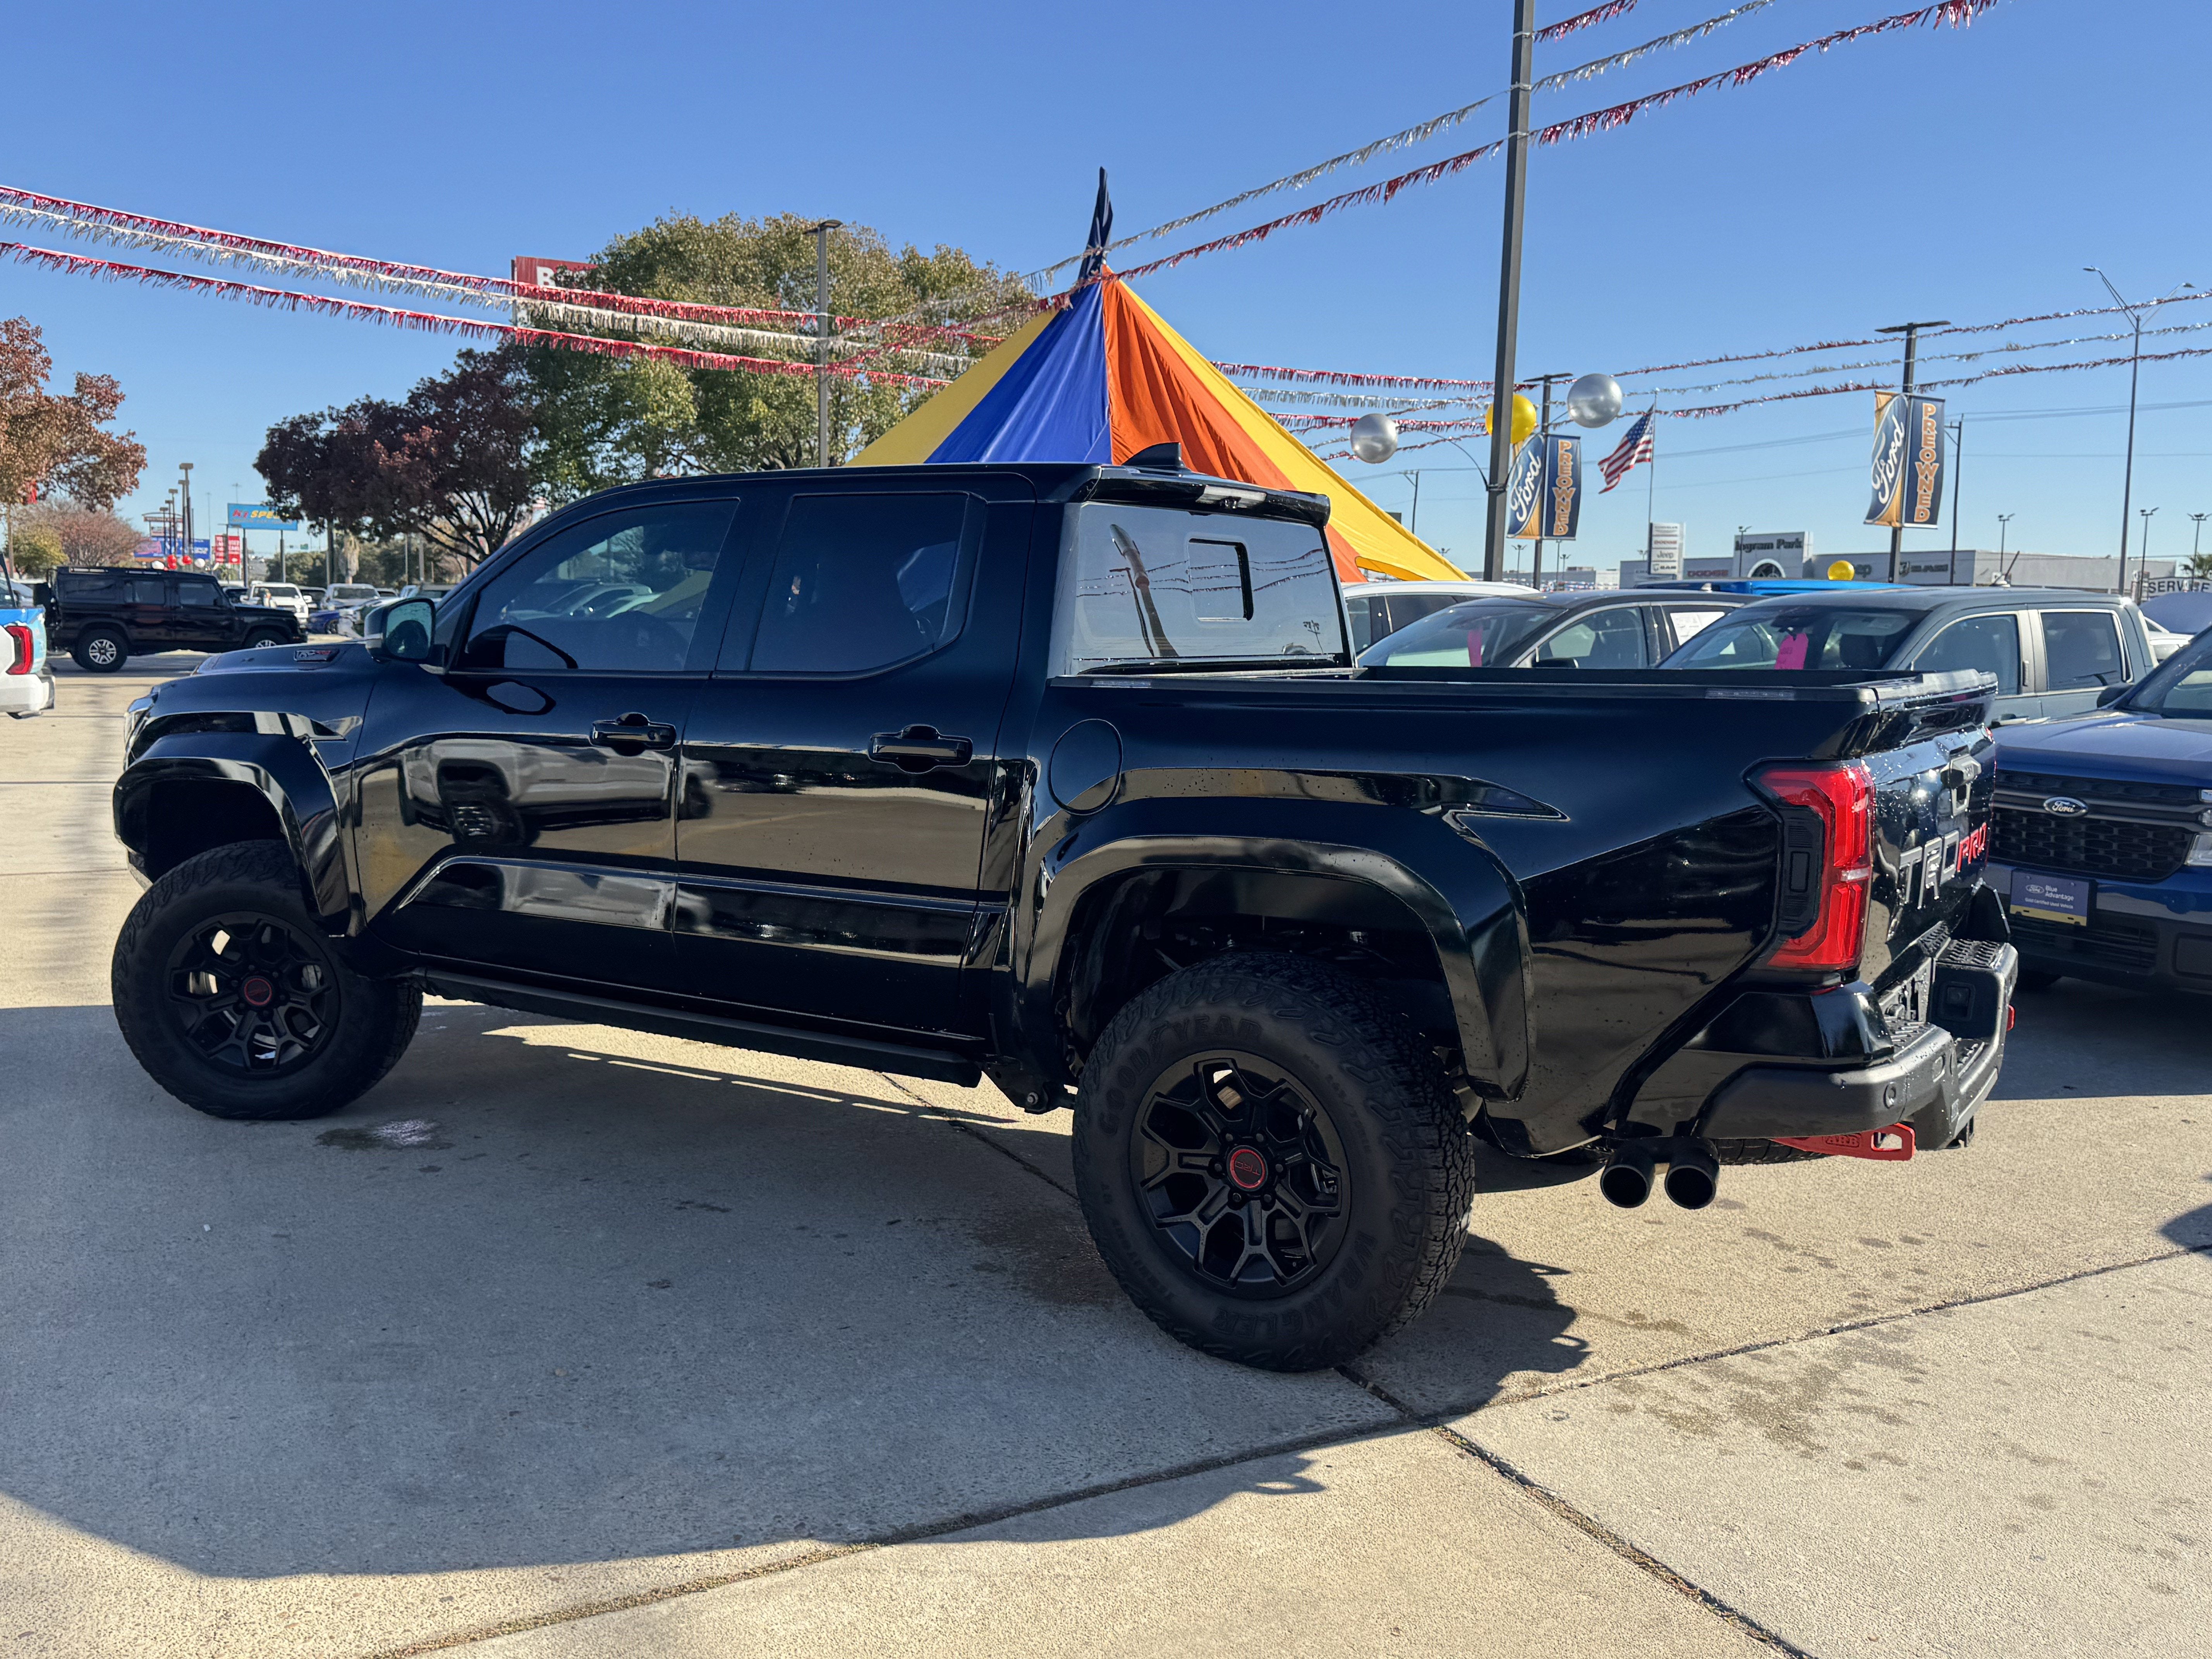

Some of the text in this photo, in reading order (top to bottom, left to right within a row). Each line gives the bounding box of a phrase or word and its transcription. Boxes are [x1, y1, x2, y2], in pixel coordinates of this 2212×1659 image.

[1510, 450, 1542, 522] Ford
[1552, 439, 1576, 536] PREOWNED
[1871, 414, 1905, 504] Ford
[1914, 402, 1939, 522] PREOWNED
[1776, 538, 1802, 549] Park
[1899, 830, 1960, 910] TRD
[2045, 884, 2057, 893] Blue
[2045, 891, 2074, 902] Advantage
[1098, 1014, 1263, 1136] GOODYEAR
[1211, 1230, 1379, 1340] WRANGLER
